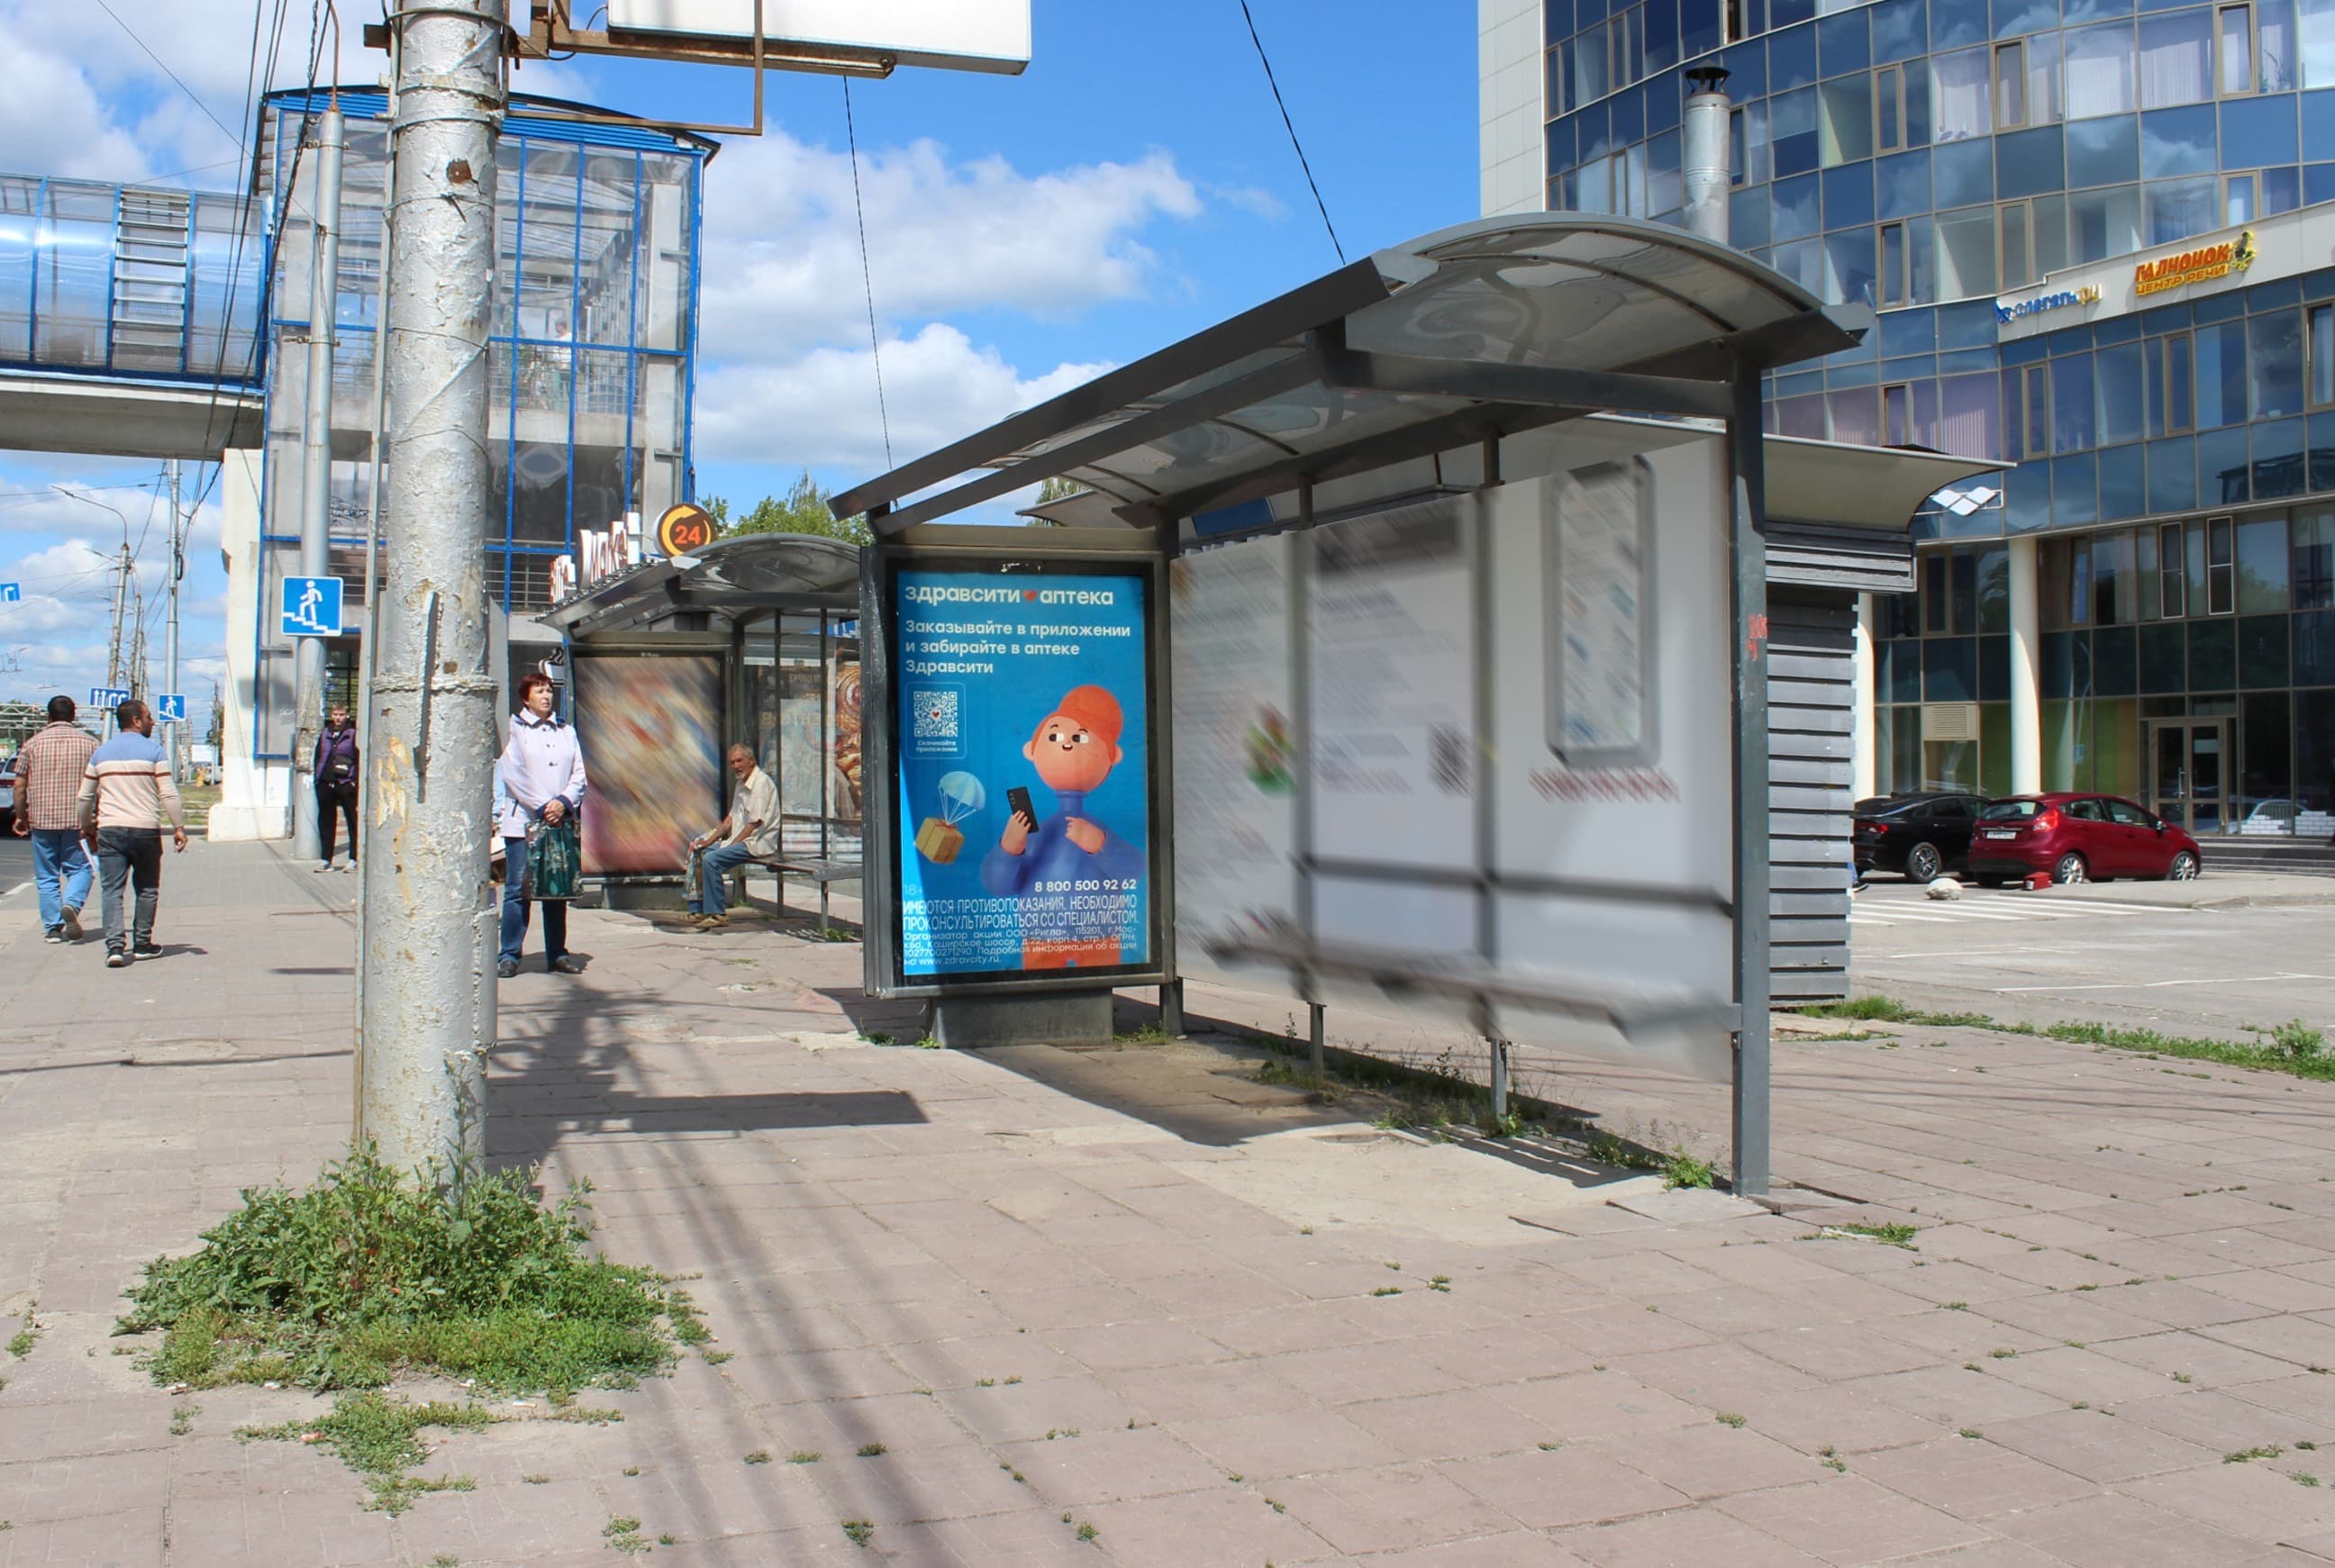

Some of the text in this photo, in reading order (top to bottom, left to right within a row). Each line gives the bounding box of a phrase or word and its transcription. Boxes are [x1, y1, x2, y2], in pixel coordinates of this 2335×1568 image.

[2135, 242, 2233, 283] ГАЛЧОНОК
[2135, 263, 2230, 296] ЦЕНТР РЕЧИ
[674, 524, 702, 545] 24
[905, 586, 1113, 606] здравсити аптека
[905, 620, 1131, 639] Заказывайте в приложении
[905, 639, 1080, 657] и забирайте в аптеке
[905, 660, 994, 675] Здравсити
[1034, 879, 1137, 892] 8 800 500 92 62
[904, 899, 954, 914] ИМЕЮТСЯ
[1070, 894, 1137, 911] НЕОБХОДИМО
[904, 910, 1139, 930] ПРОКОНСУЛЬТИРОВАТЬСЯ СО СПЕЦИАЛИСТОМ.
[904, 931, 968, 942] Организатор
[1005, 929, 1028, 938] ООО
